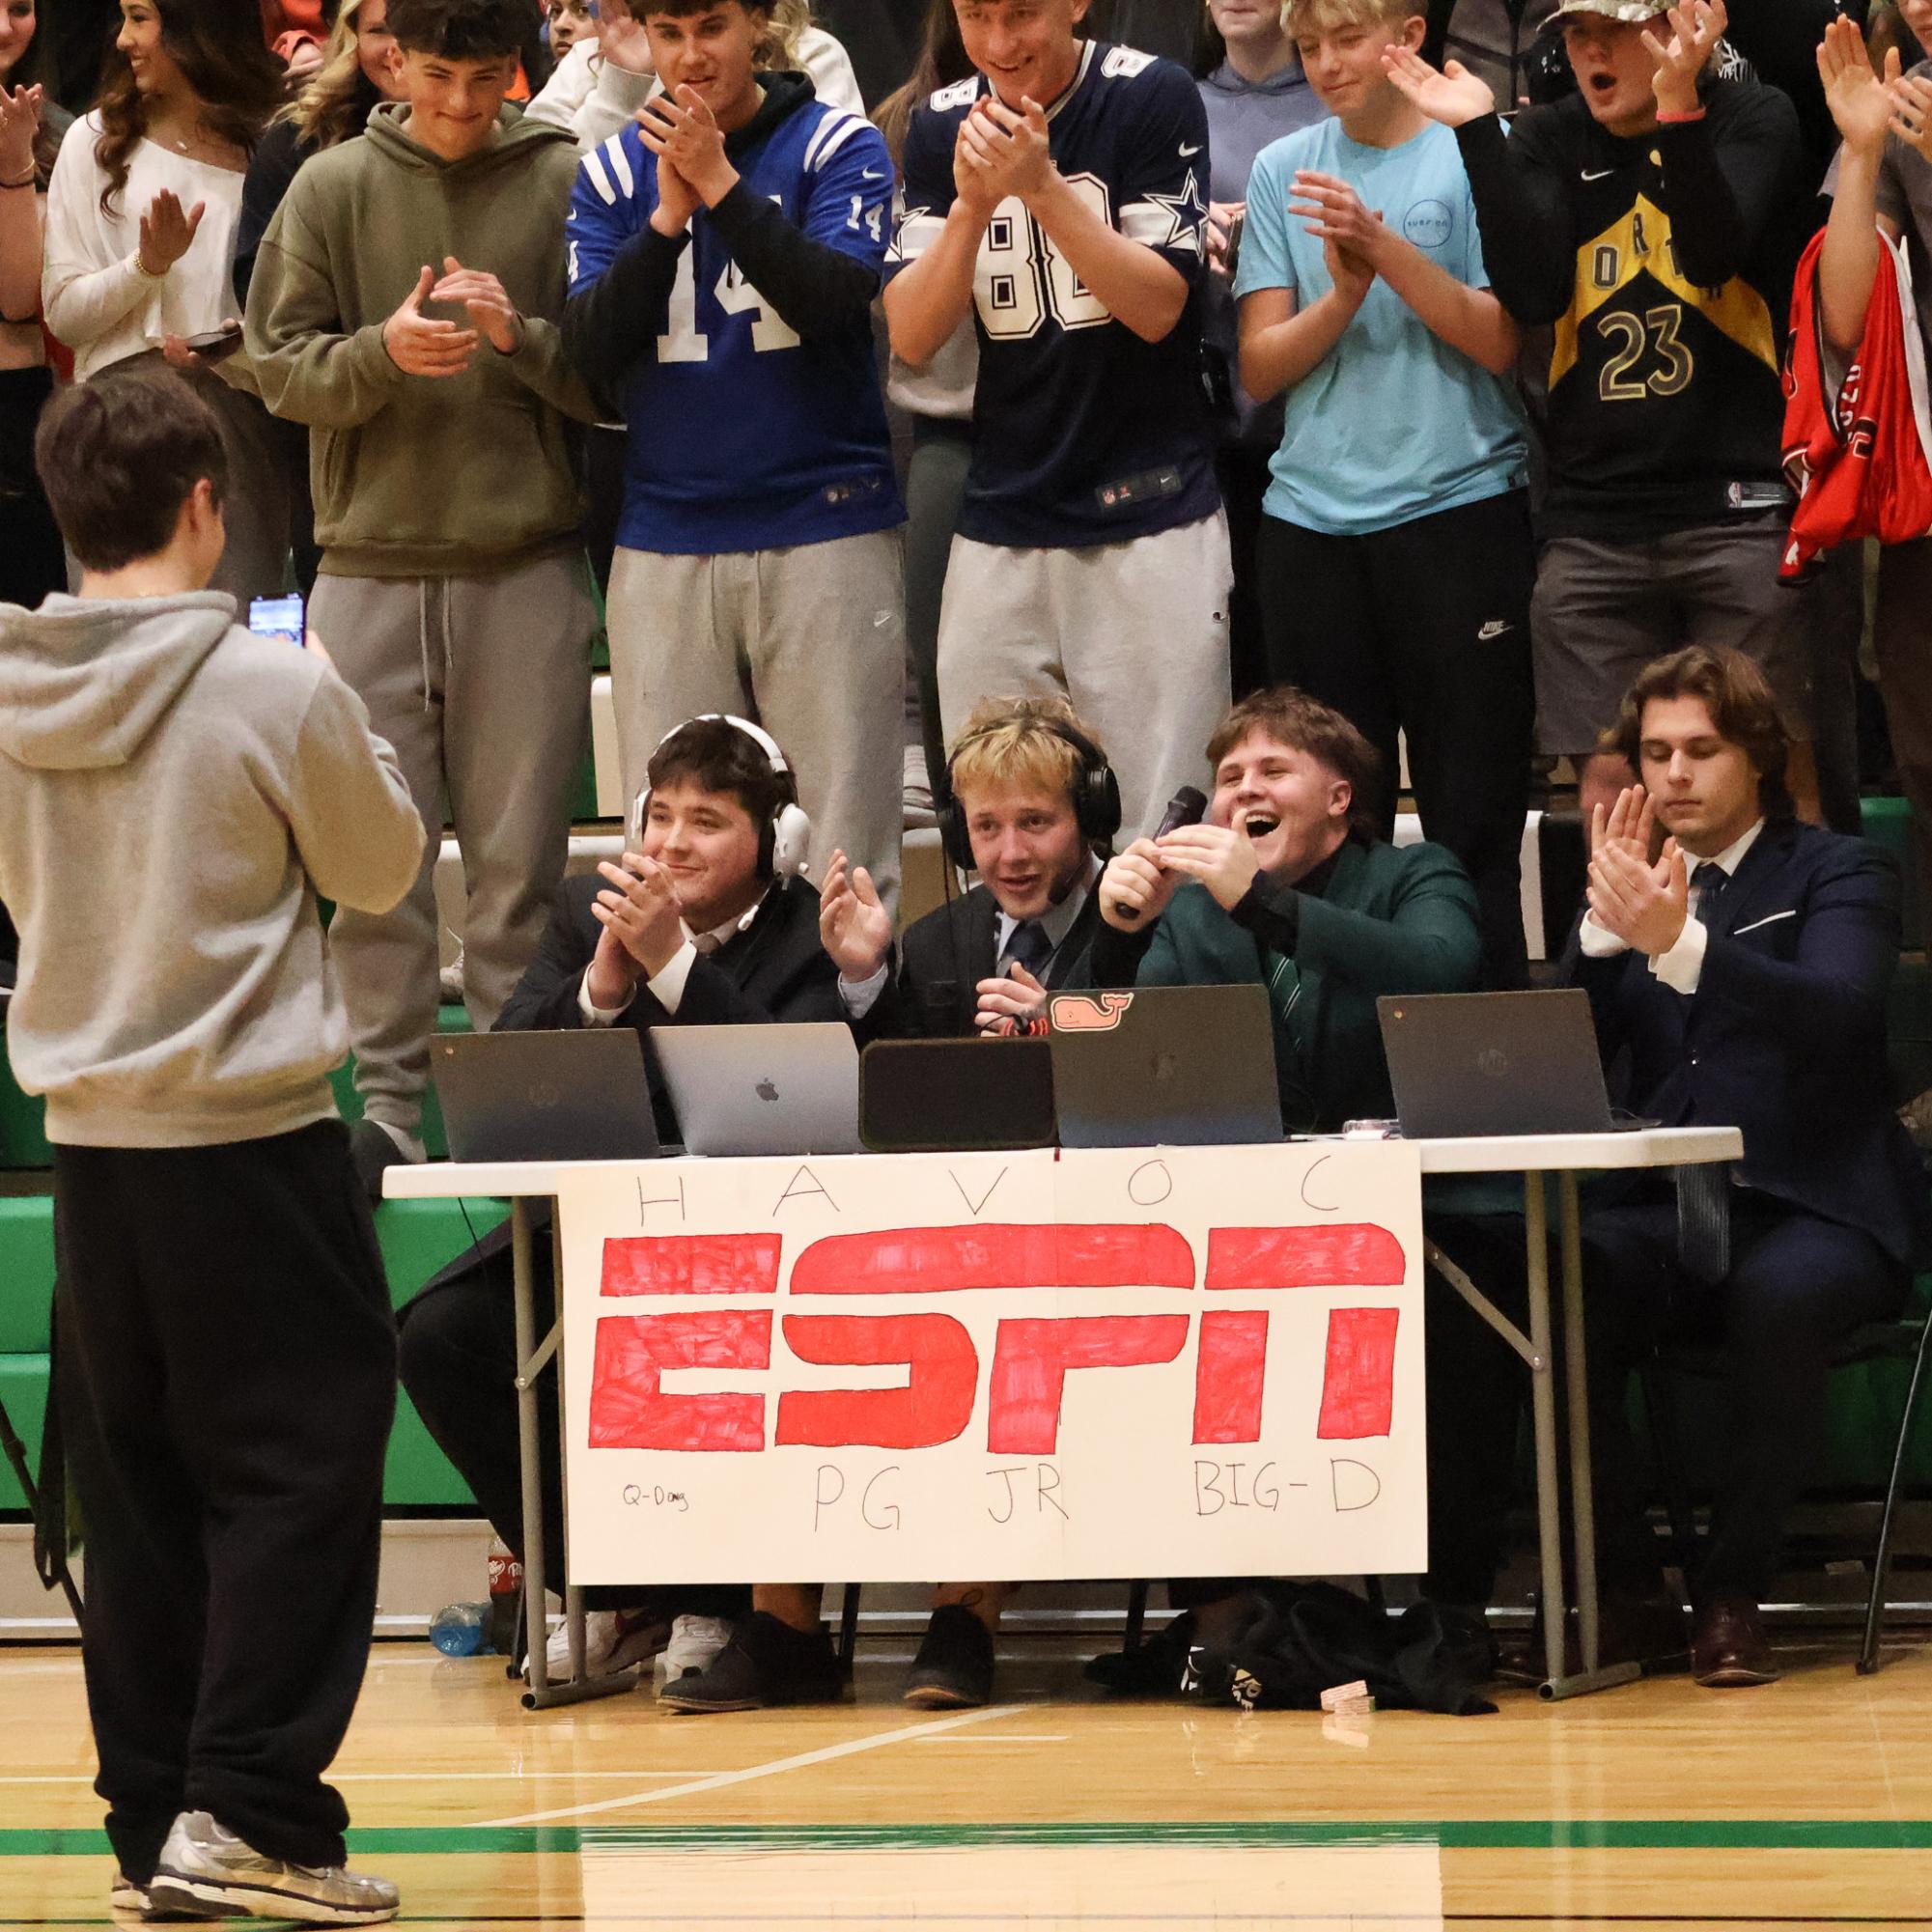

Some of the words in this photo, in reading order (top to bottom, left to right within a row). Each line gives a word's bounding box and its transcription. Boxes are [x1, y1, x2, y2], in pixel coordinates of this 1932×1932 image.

[847, 195, 885, 242] 14
[1597, 304, 1694, 401] 23
[637, 1156, 1339, 1226] HAVOC
[588, 1222, 1406, 1455] ESPN
[814, 1465, 900, 1532] PG
[986, 1463, 1069, 1524] JR
[1194, 1459, 1381, 1517] BIG-D
